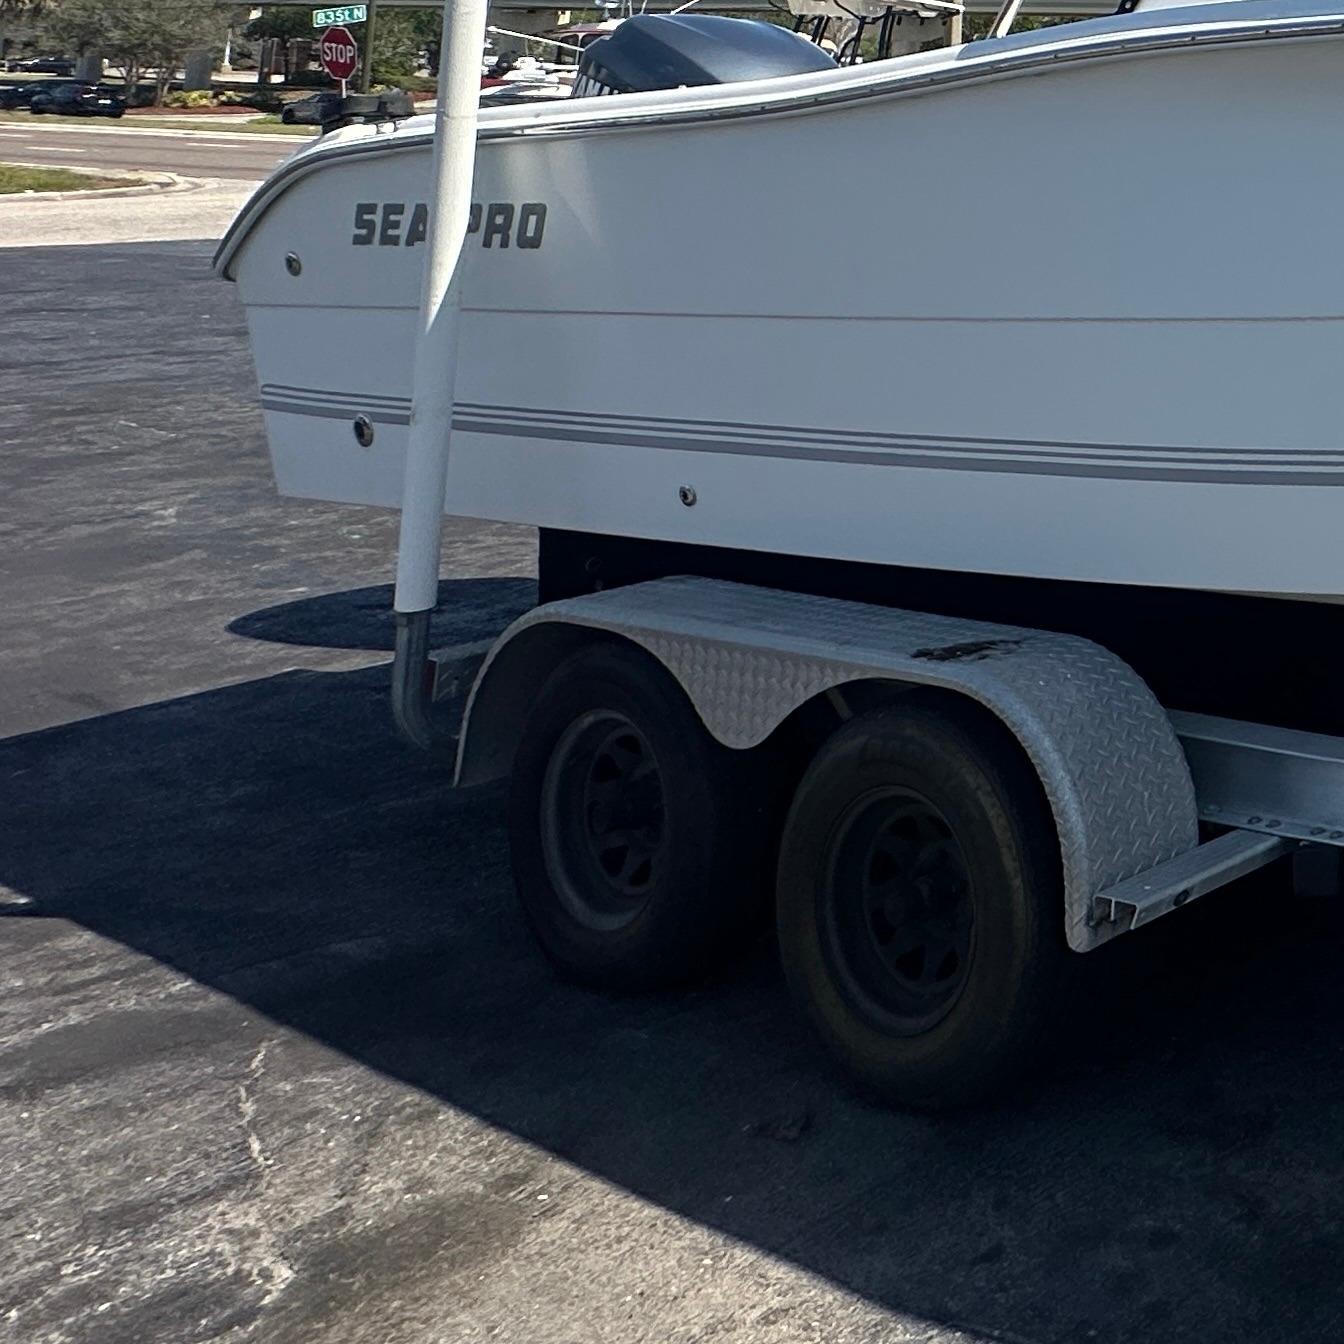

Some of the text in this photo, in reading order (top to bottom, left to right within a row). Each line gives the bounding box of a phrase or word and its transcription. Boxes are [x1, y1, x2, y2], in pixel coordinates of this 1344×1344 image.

[353, 7, 363, 19] N
[322, 42, 354, 63] STOP
[352, 203, 428, 247] SEA
